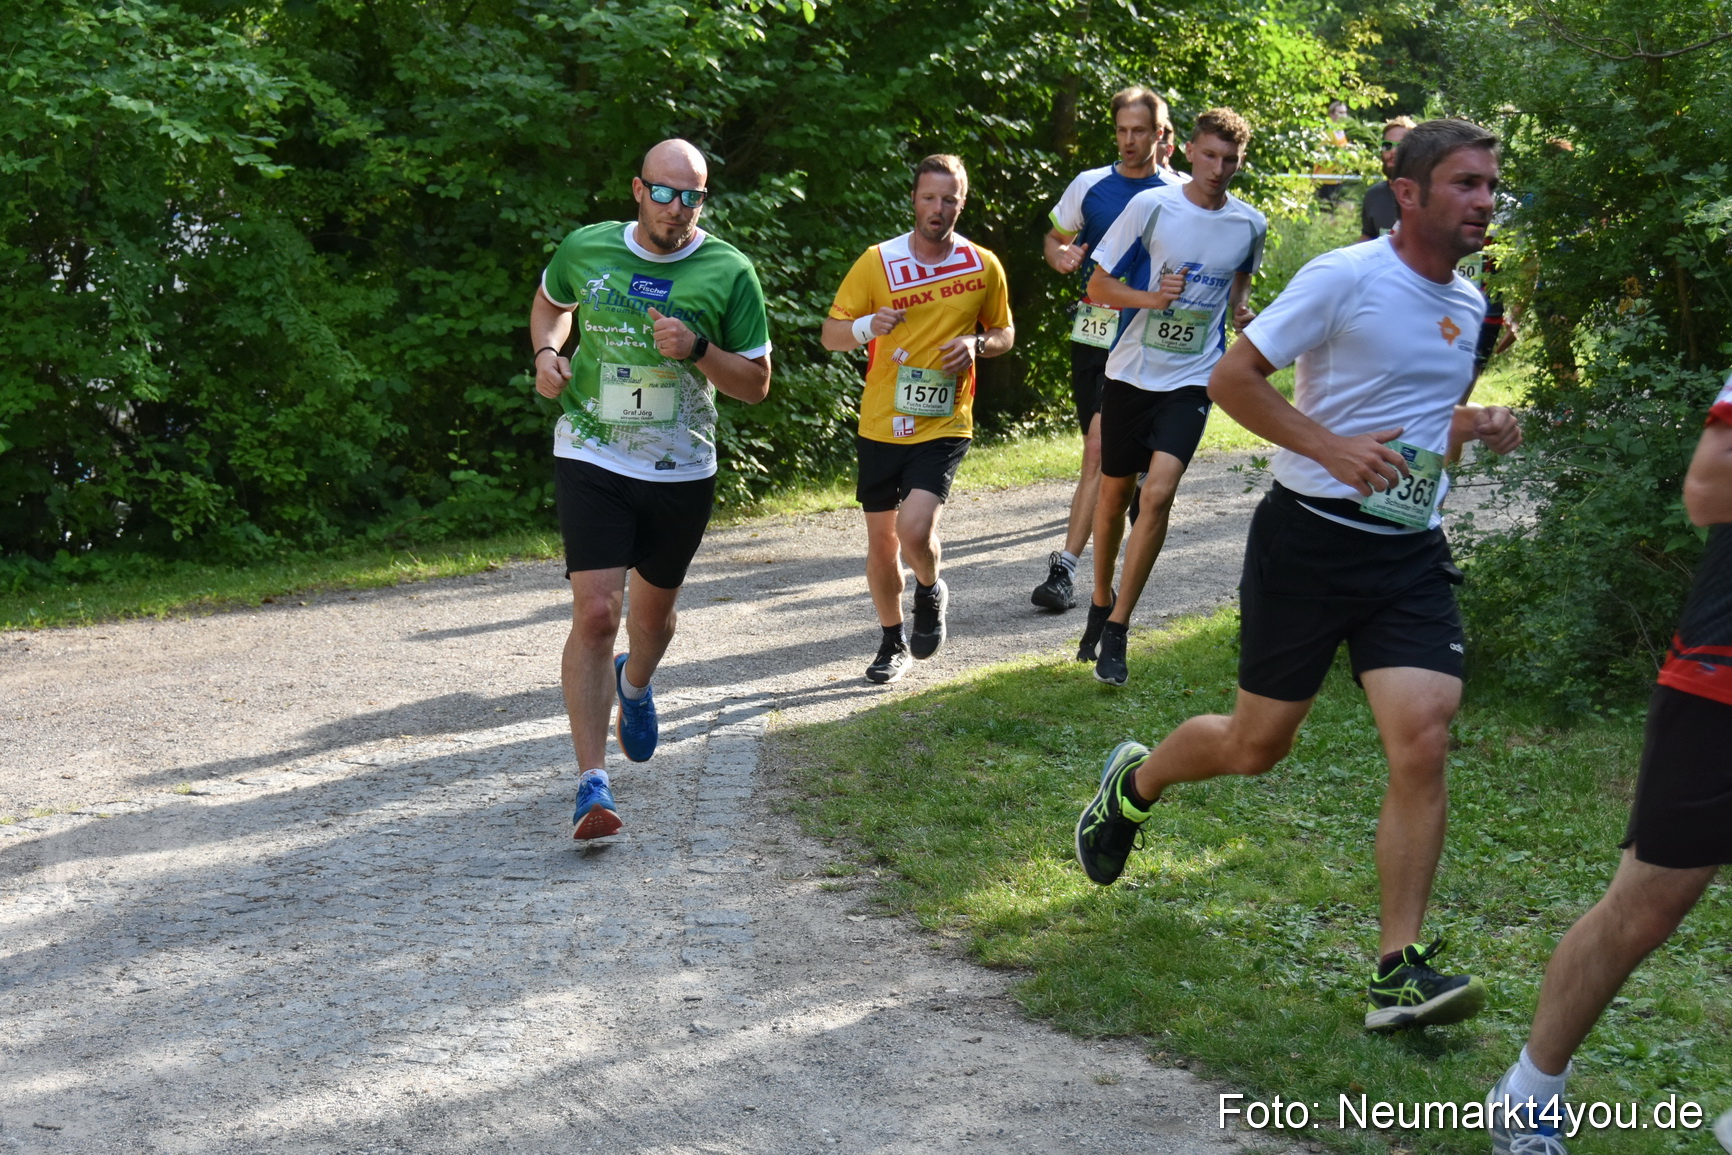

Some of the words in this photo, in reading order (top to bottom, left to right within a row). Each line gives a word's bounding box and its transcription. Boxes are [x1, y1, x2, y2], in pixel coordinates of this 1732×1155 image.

[638, 283, 669, 296] Fischer
[891, 289, 935, 311] MAX
[939, 278, 987, 299] BÖGL
[584, 319, 637, 334] Gesunde
[1081, 318, 1107, 336] 215
[1158, 322, 1195, 342] 825
[605, 335, 647, 349] laufen
[631, 387, 642, 409] 1
[903, 383, 949, 404] 1570
[637, 409, 653, 417] Jörg
